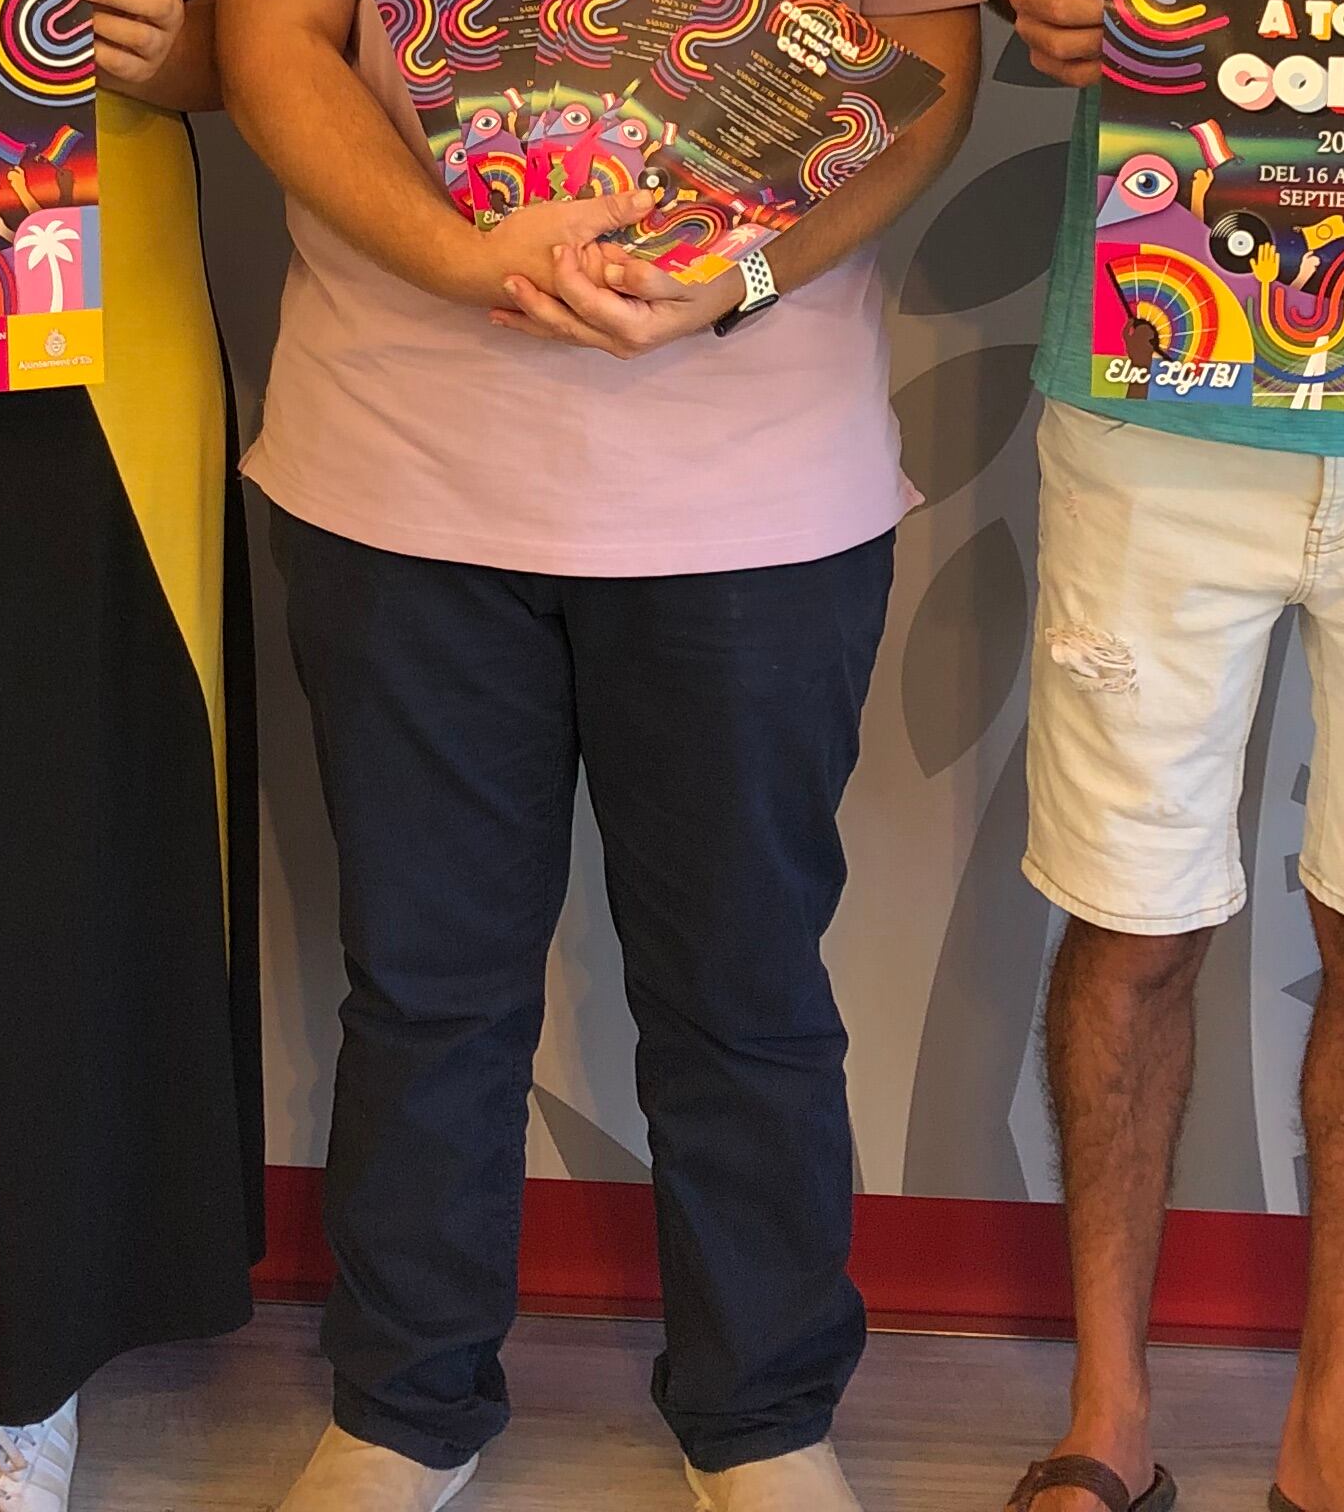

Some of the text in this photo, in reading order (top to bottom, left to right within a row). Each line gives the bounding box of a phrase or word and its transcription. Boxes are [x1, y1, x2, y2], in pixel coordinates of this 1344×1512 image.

[780, 1, 859, 61] ORGULLOSA
[792, 28, 830, 57] A TODO
[777, 36, 827, 77] COLOR
[1259, 165, 1300, 182] DEL
[1307, 166, 1327, 184] 16
[1104, 357, 1240, 398] Elx LGTBI
